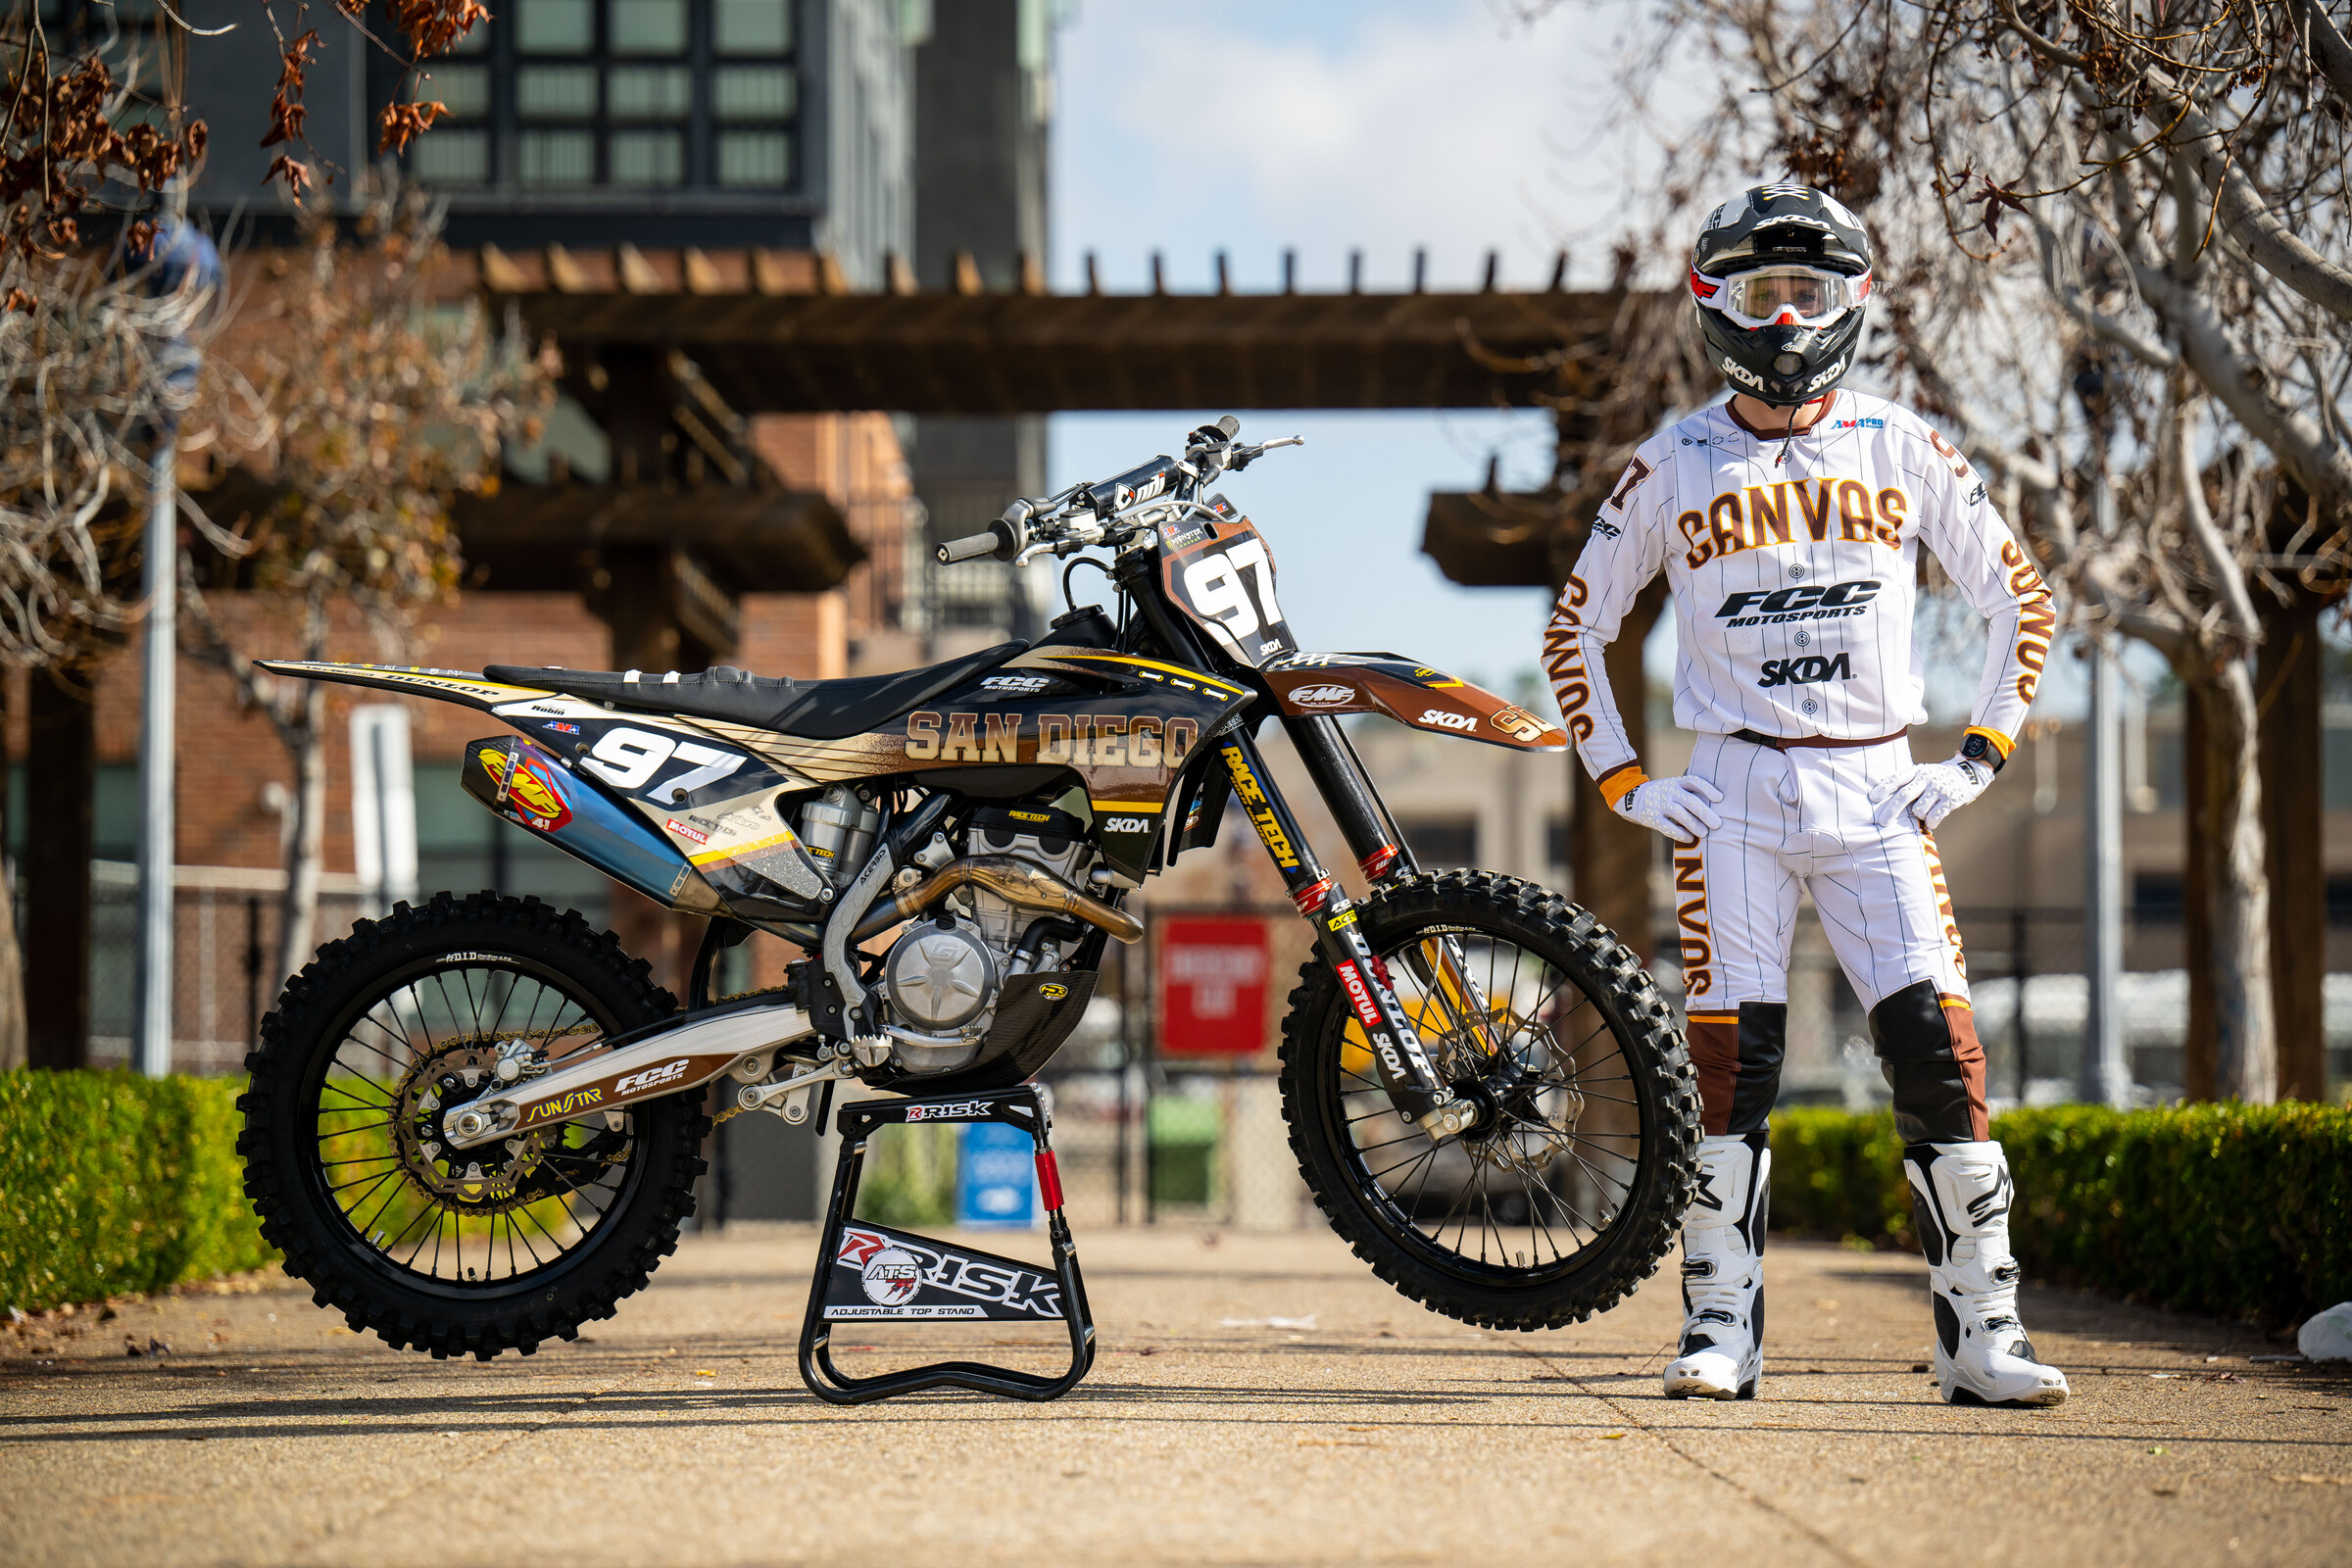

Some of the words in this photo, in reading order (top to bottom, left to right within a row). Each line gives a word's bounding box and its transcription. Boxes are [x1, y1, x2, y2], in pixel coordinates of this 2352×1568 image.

[1722, 356, 1764, 392] SKDA
[1807, 354, 1846, 392] SKDA
[1830, 419, 1865, 429] AMA
[1678, 477, 1907, 569] CANVAS
[1183, 538, 1283, 646] 97
[1714, 580, 1882, 617] FCC
[1726, 606, 1867, 628] MOTOSPORTS
[1259, 638, 1283, 657] SKDA
[383, 675, 500, 696] DUNLOP
[980, 676, 1050, 688] FCC
[1757, 653, 1851, 687] SKDA
[531, 705, 565, 715] Robin
[1288, 687, 1355, 702] FMF
[1418, 709, 1478, 732] SKDA
[905, 710, 1022, 763] SAN
[1036, 712, 1199, 768] DIEGO
[579, 726, 748, 806] 97
[1008, 809, 1029, 819] RACE
[1029, 812, 1051, 822] TECH
[1220, 746, 1266, 805] RACE
[1255, 808, 1299, 868] TECH
[1230, 776, 1248, 805] GOLD
[1246, 807, 1270, 847] VALVES
[668, 820, 707, 844] MOTUL
[1104, 817, 1149, 833] SKDA
[859, 850, 886, 885] ACERBIS
[1339, 965, 1378, 1024] MOTUL
[1373, 1032, 1406, 1080] SKDA
[614, 1058, 690, 1093] FCC
[620, 1072, 684, 1096] MOTOSPORTS
[525, 1087, 604, 1123] SUNSTAR
